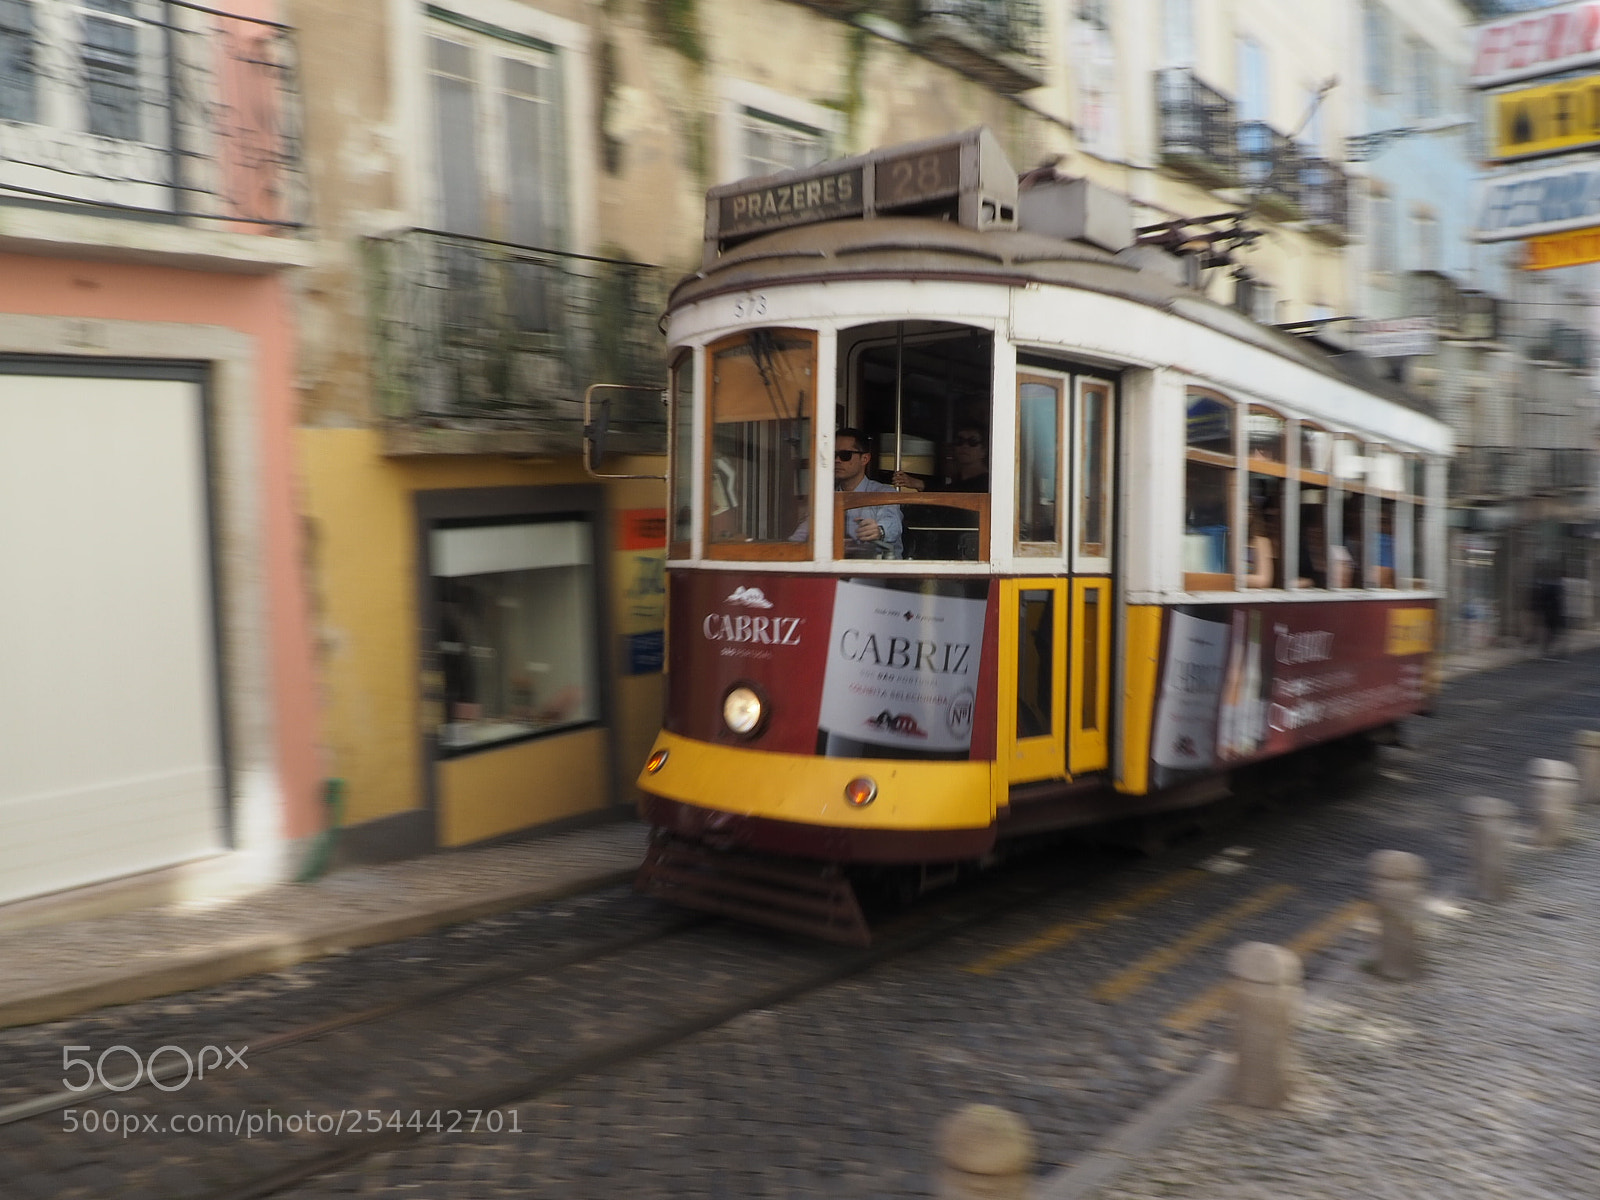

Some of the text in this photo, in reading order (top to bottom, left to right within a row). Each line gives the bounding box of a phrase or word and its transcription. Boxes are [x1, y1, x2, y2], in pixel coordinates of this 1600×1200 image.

[733, 154, 941, 219] PRAZERES 28
[703, 613, 801, 645] CABRIZ
[841, 628, 970, 675] CABRIZ
